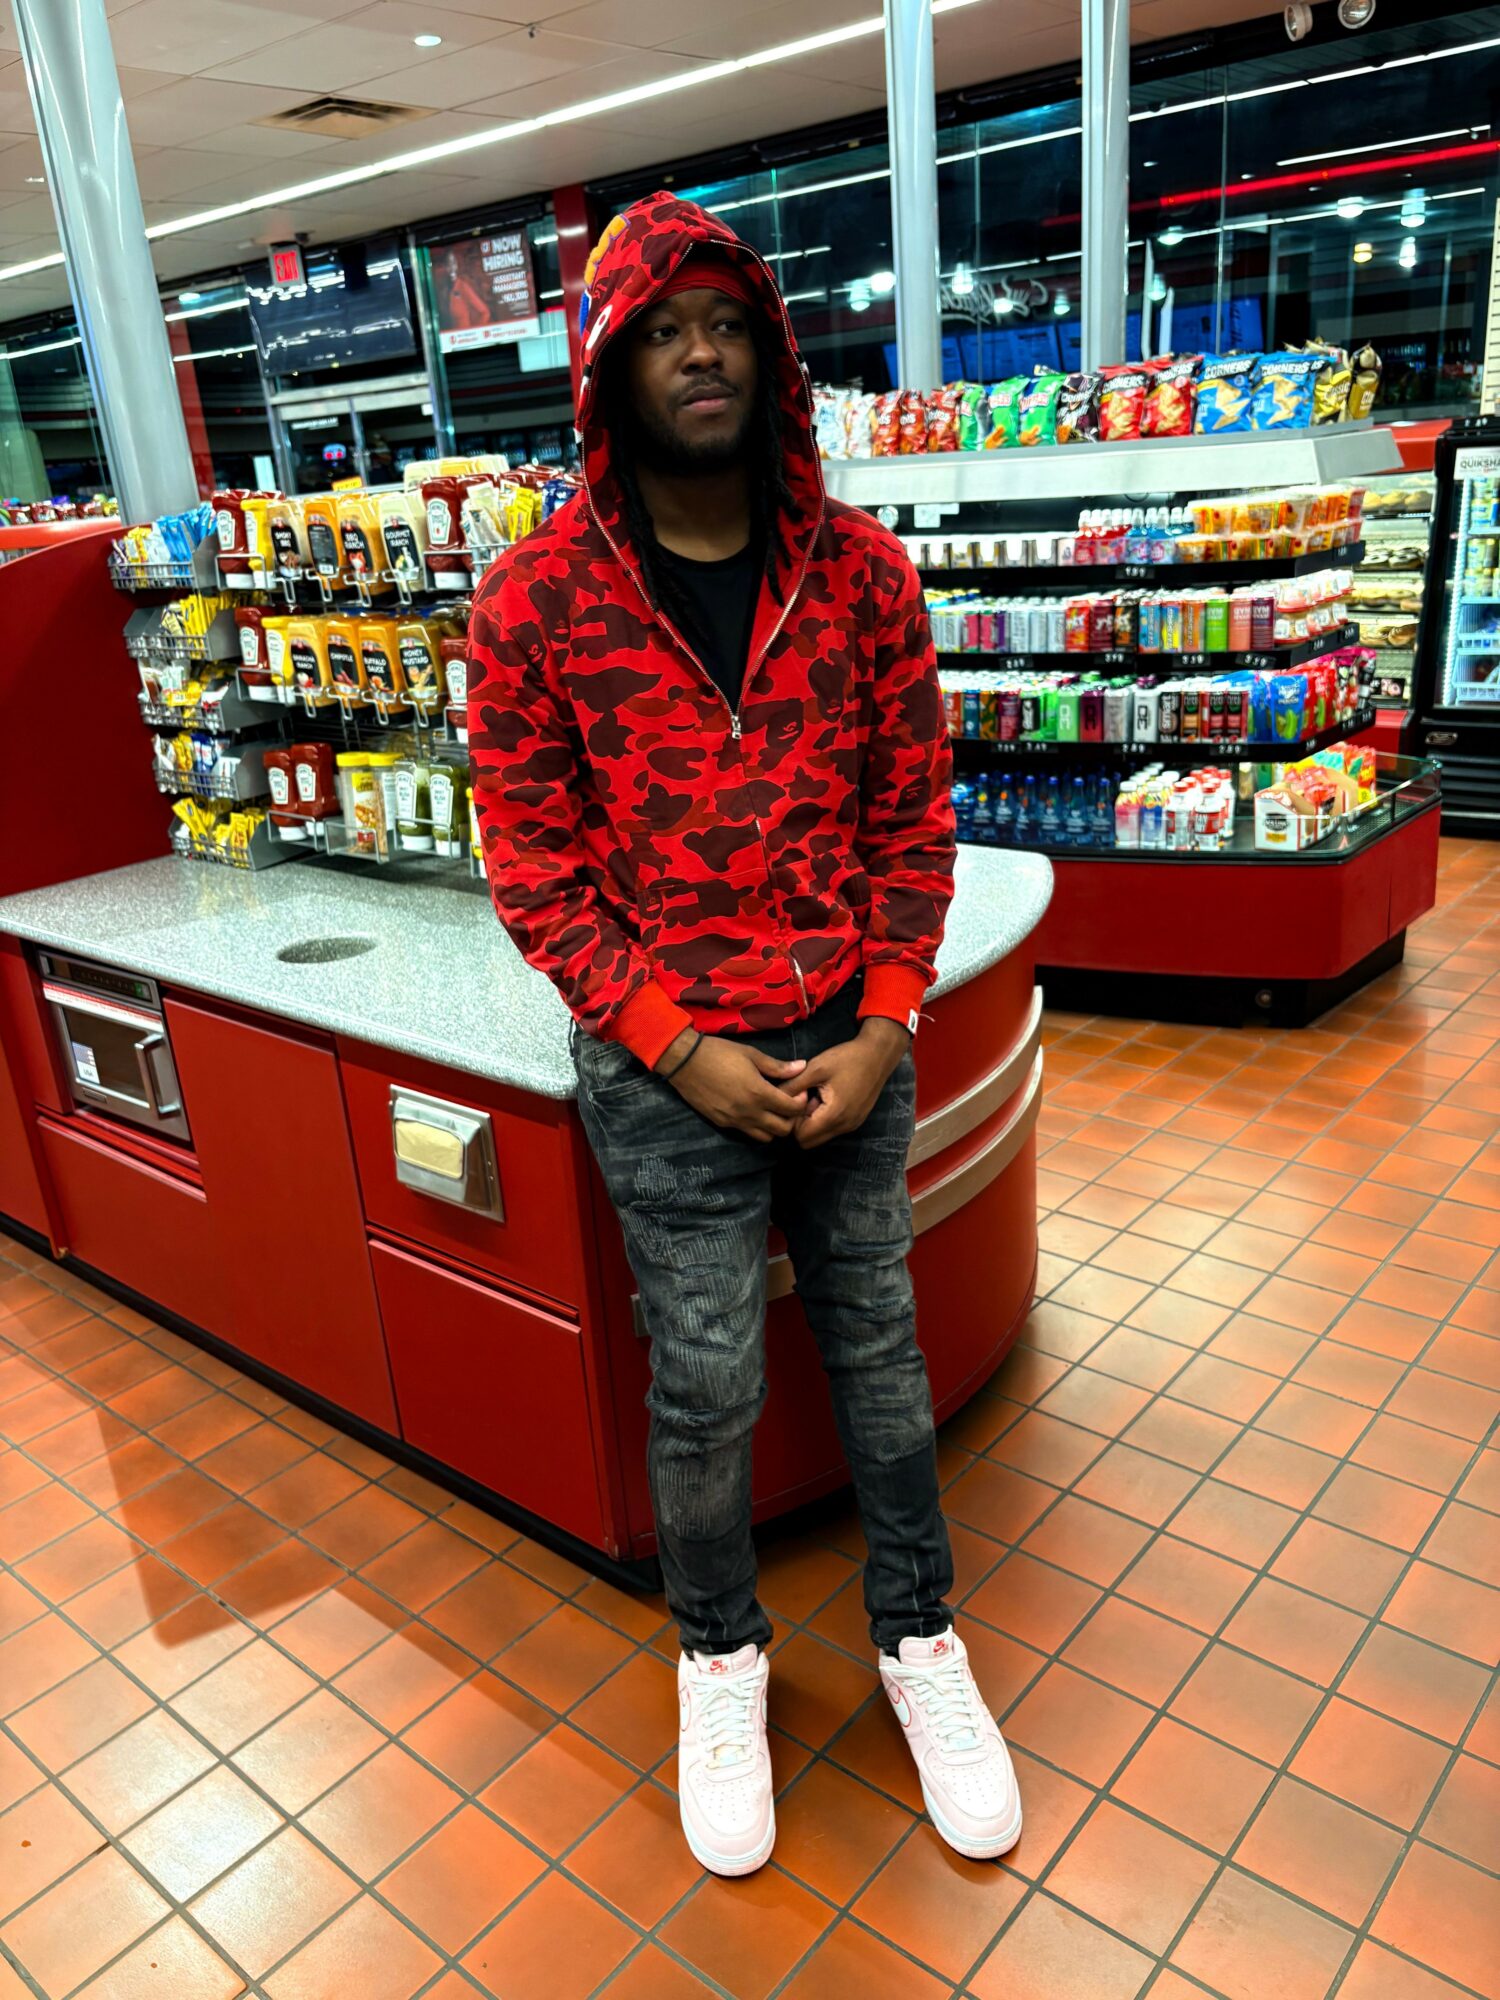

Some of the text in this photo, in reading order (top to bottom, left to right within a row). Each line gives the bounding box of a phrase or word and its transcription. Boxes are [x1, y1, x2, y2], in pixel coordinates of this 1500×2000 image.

[491, 234, 521, 254] NOW
[482, 250, 525, 272] HIRING
[402, 656, 429, 665] MUSTARD
